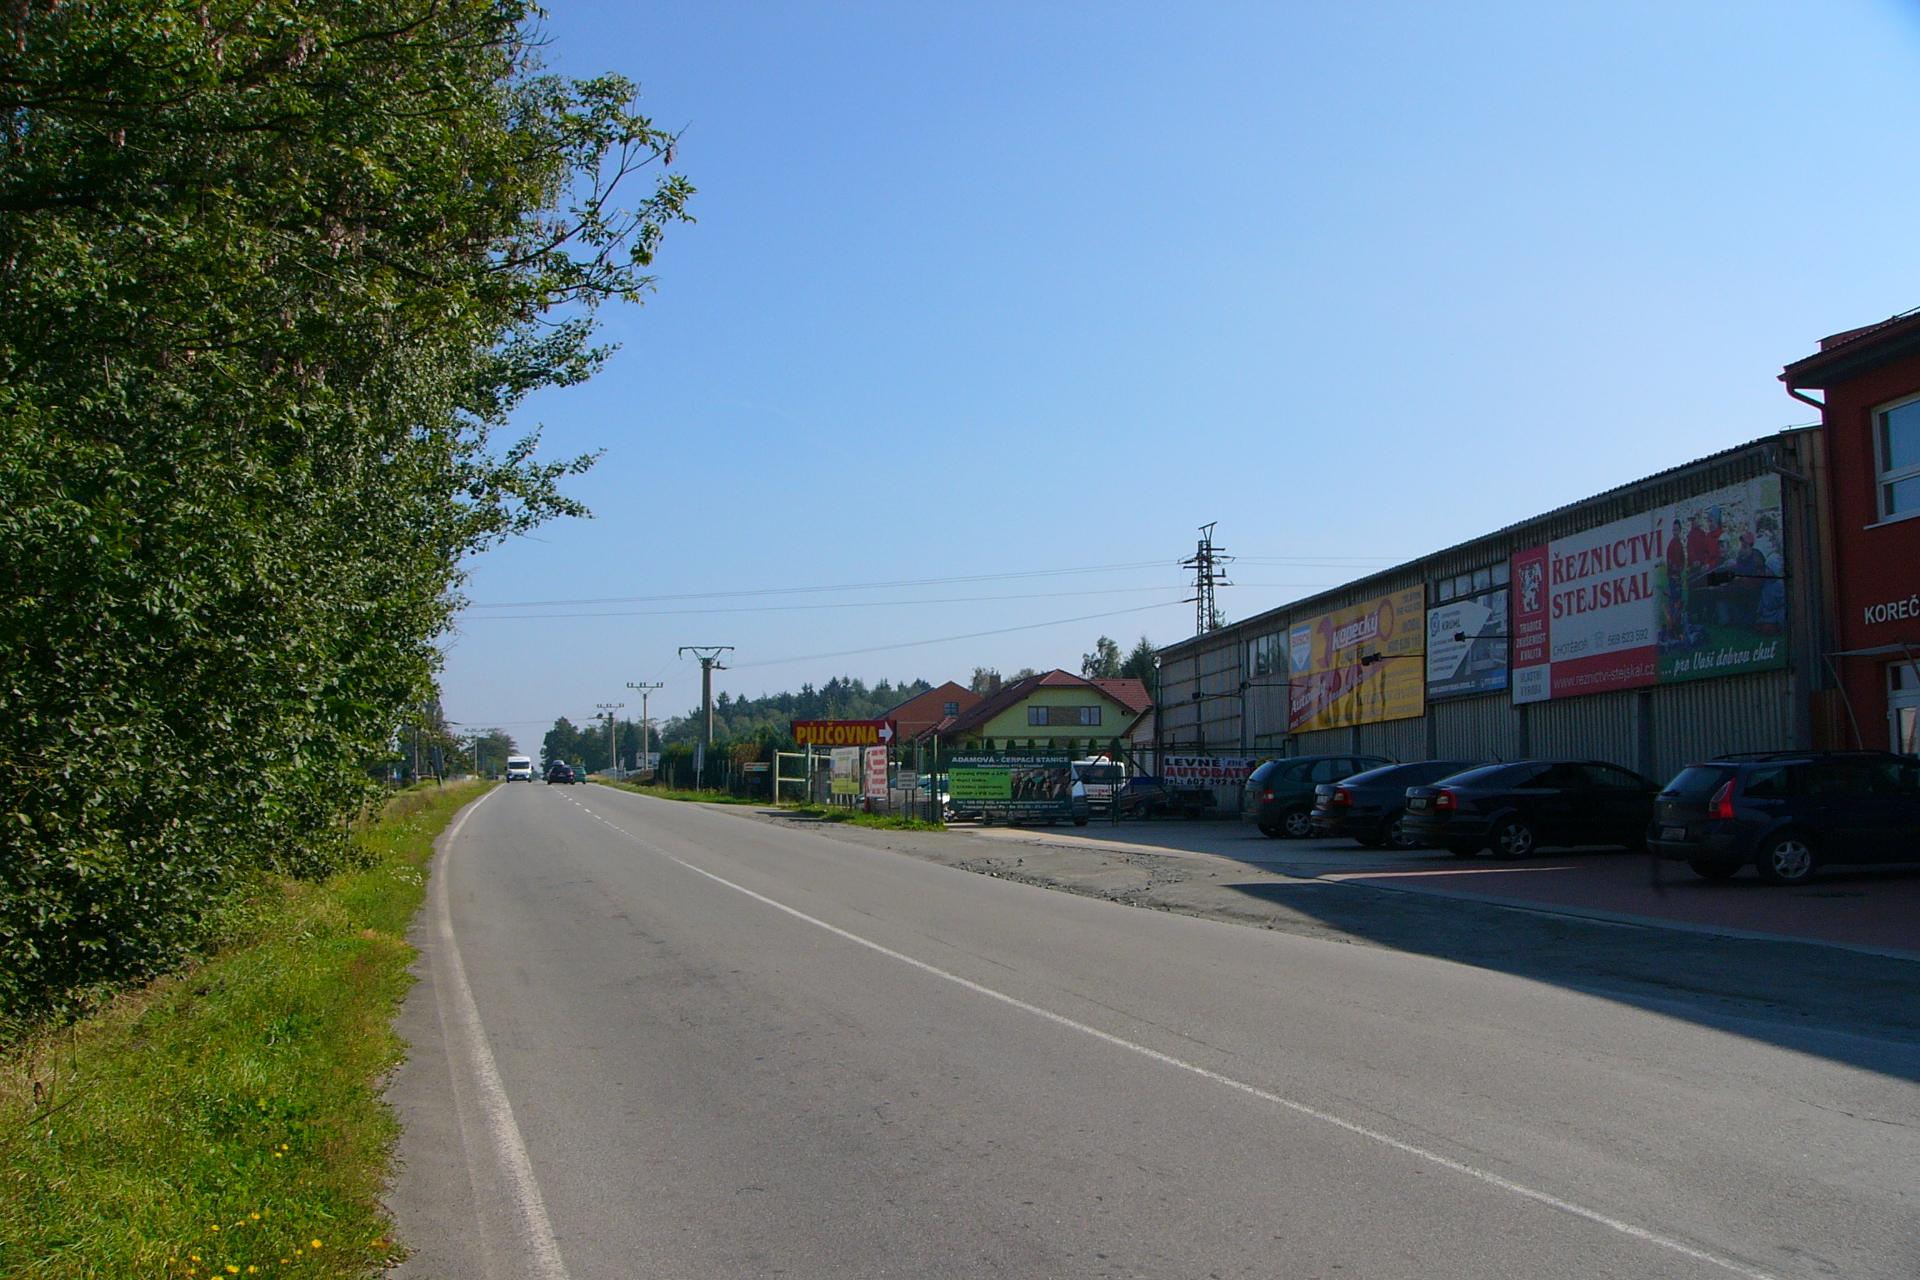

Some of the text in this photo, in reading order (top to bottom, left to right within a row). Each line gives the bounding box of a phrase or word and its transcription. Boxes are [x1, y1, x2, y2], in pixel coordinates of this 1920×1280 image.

[1552, 518, 1662, 585] ŘEZNICTVÍ
[1552, 572, 1654, 619] STEJSKAL
[1864, 594, 1919, 624] KOREČ
[1673, 659, 1690, 677] pro
[1693, 651, 1715, 670] Vaši
[1716, 647, 1750, 667] dobrou
[796, 722, 877, 744] PŮJČOVNA
[1166, 767, 1256, 778] AUTOBATE
